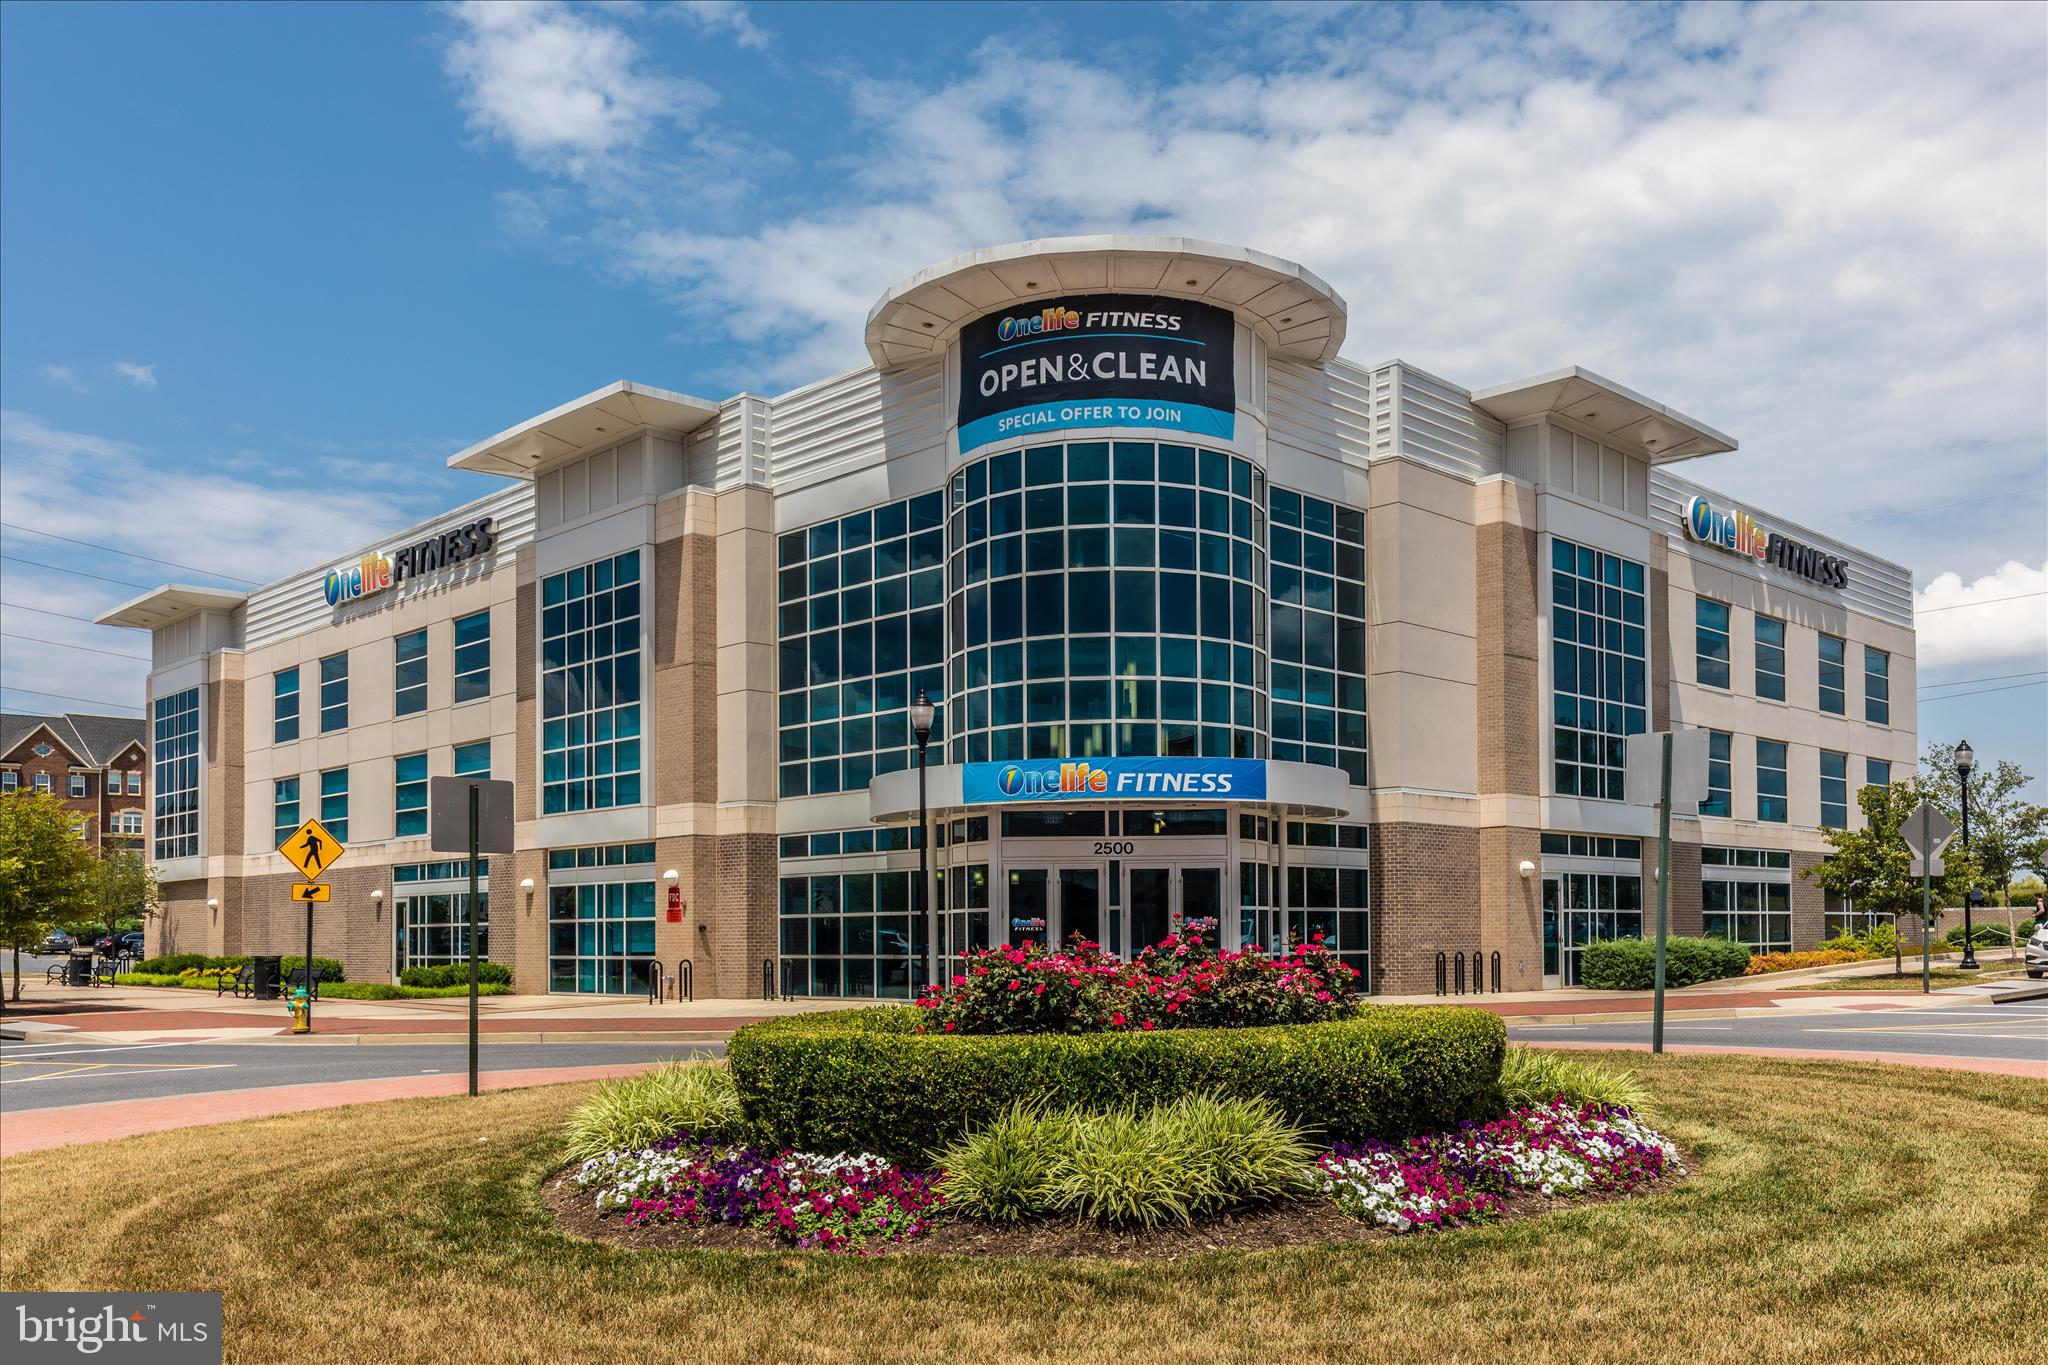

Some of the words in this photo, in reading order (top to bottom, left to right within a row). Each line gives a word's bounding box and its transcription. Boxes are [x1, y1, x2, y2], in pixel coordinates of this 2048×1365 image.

[998, 306, 1080, 342] Onelife
[1086, 311, 1182, 331] FITNESS
[998, 410, 1056, 432] SPECIAL
[1061, 406, 1113, 421] OFFER
[1118, 406, 1142, 419] TO
[1145, 408, 1182, 422] JOIN
[1686, 495, 1767, 561] Onelife
[1765, 533, 1850, 590] FITNESS
[323, 551, 393, 607] Onelife
[393, 517, 493, 582] FITNESS
[998, 763, 1108, 796] Onelife
[1117, 773, 1233, 793] FITNESS
[1094, 842, 1134, 855] 2500
